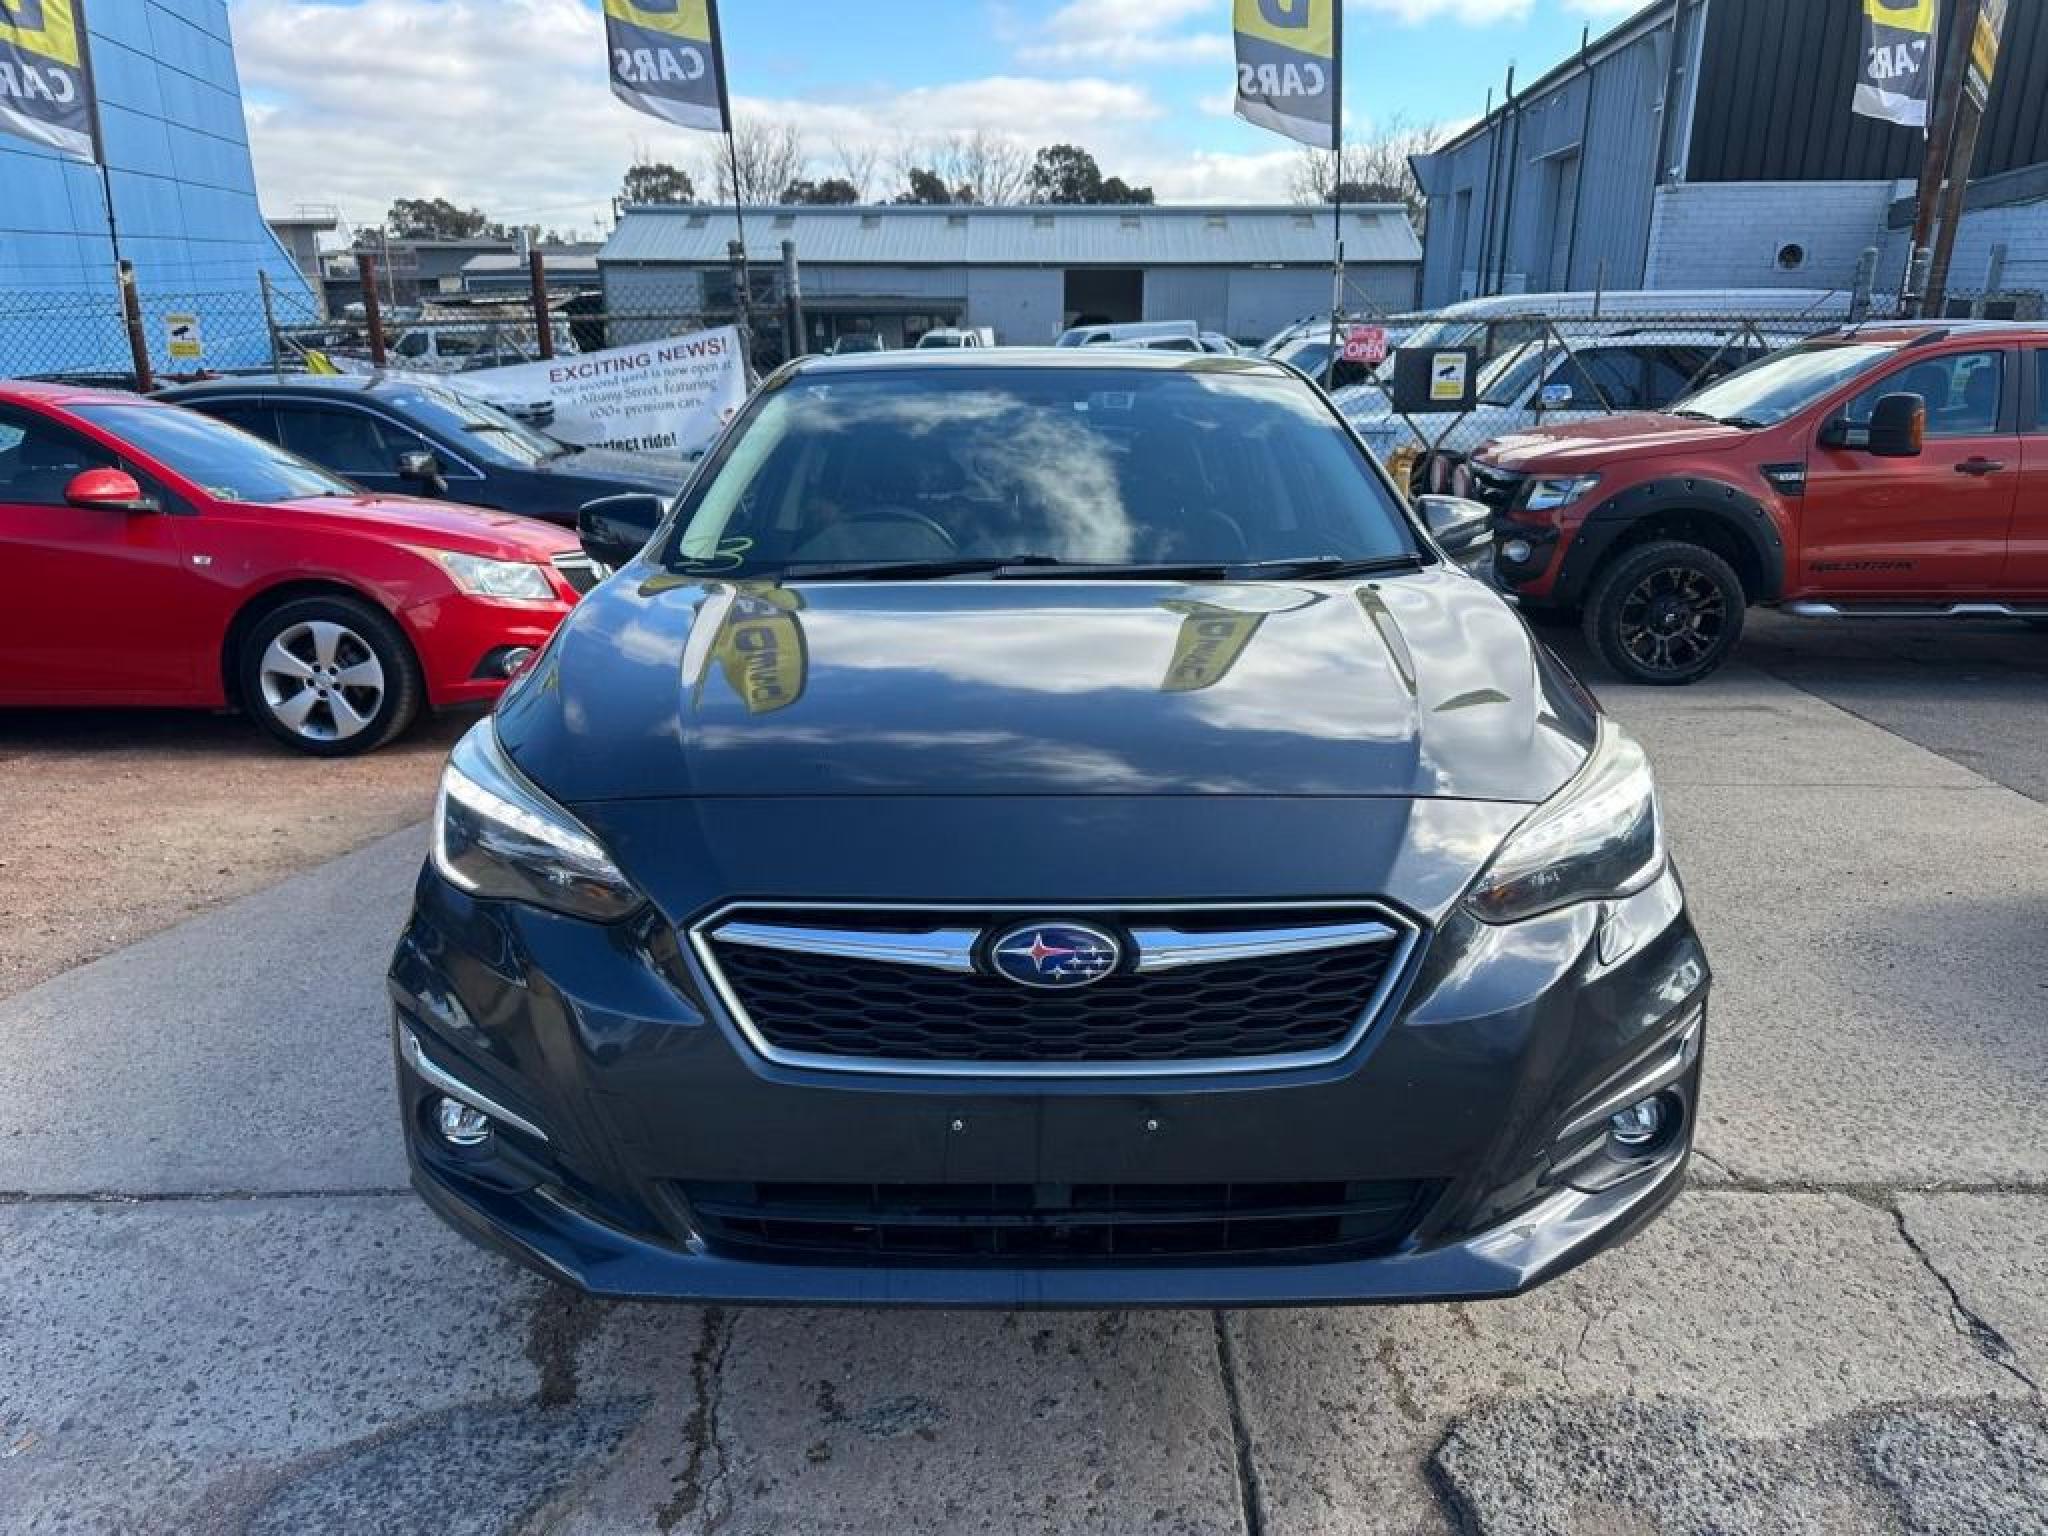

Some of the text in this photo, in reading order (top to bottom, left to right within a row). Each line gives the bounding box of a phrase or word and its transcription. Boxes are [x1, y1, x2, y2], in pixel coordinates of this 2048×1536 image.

[1347, 342, 1384, 359] OPEN
[550, 336, 727, 383] EXCITING NEWS!
[664, 366, 688, 379] now
[690, 362, 719, 378] open
[624, 401, 676, 418] premium
[641, 431, 677, 449] ride!
